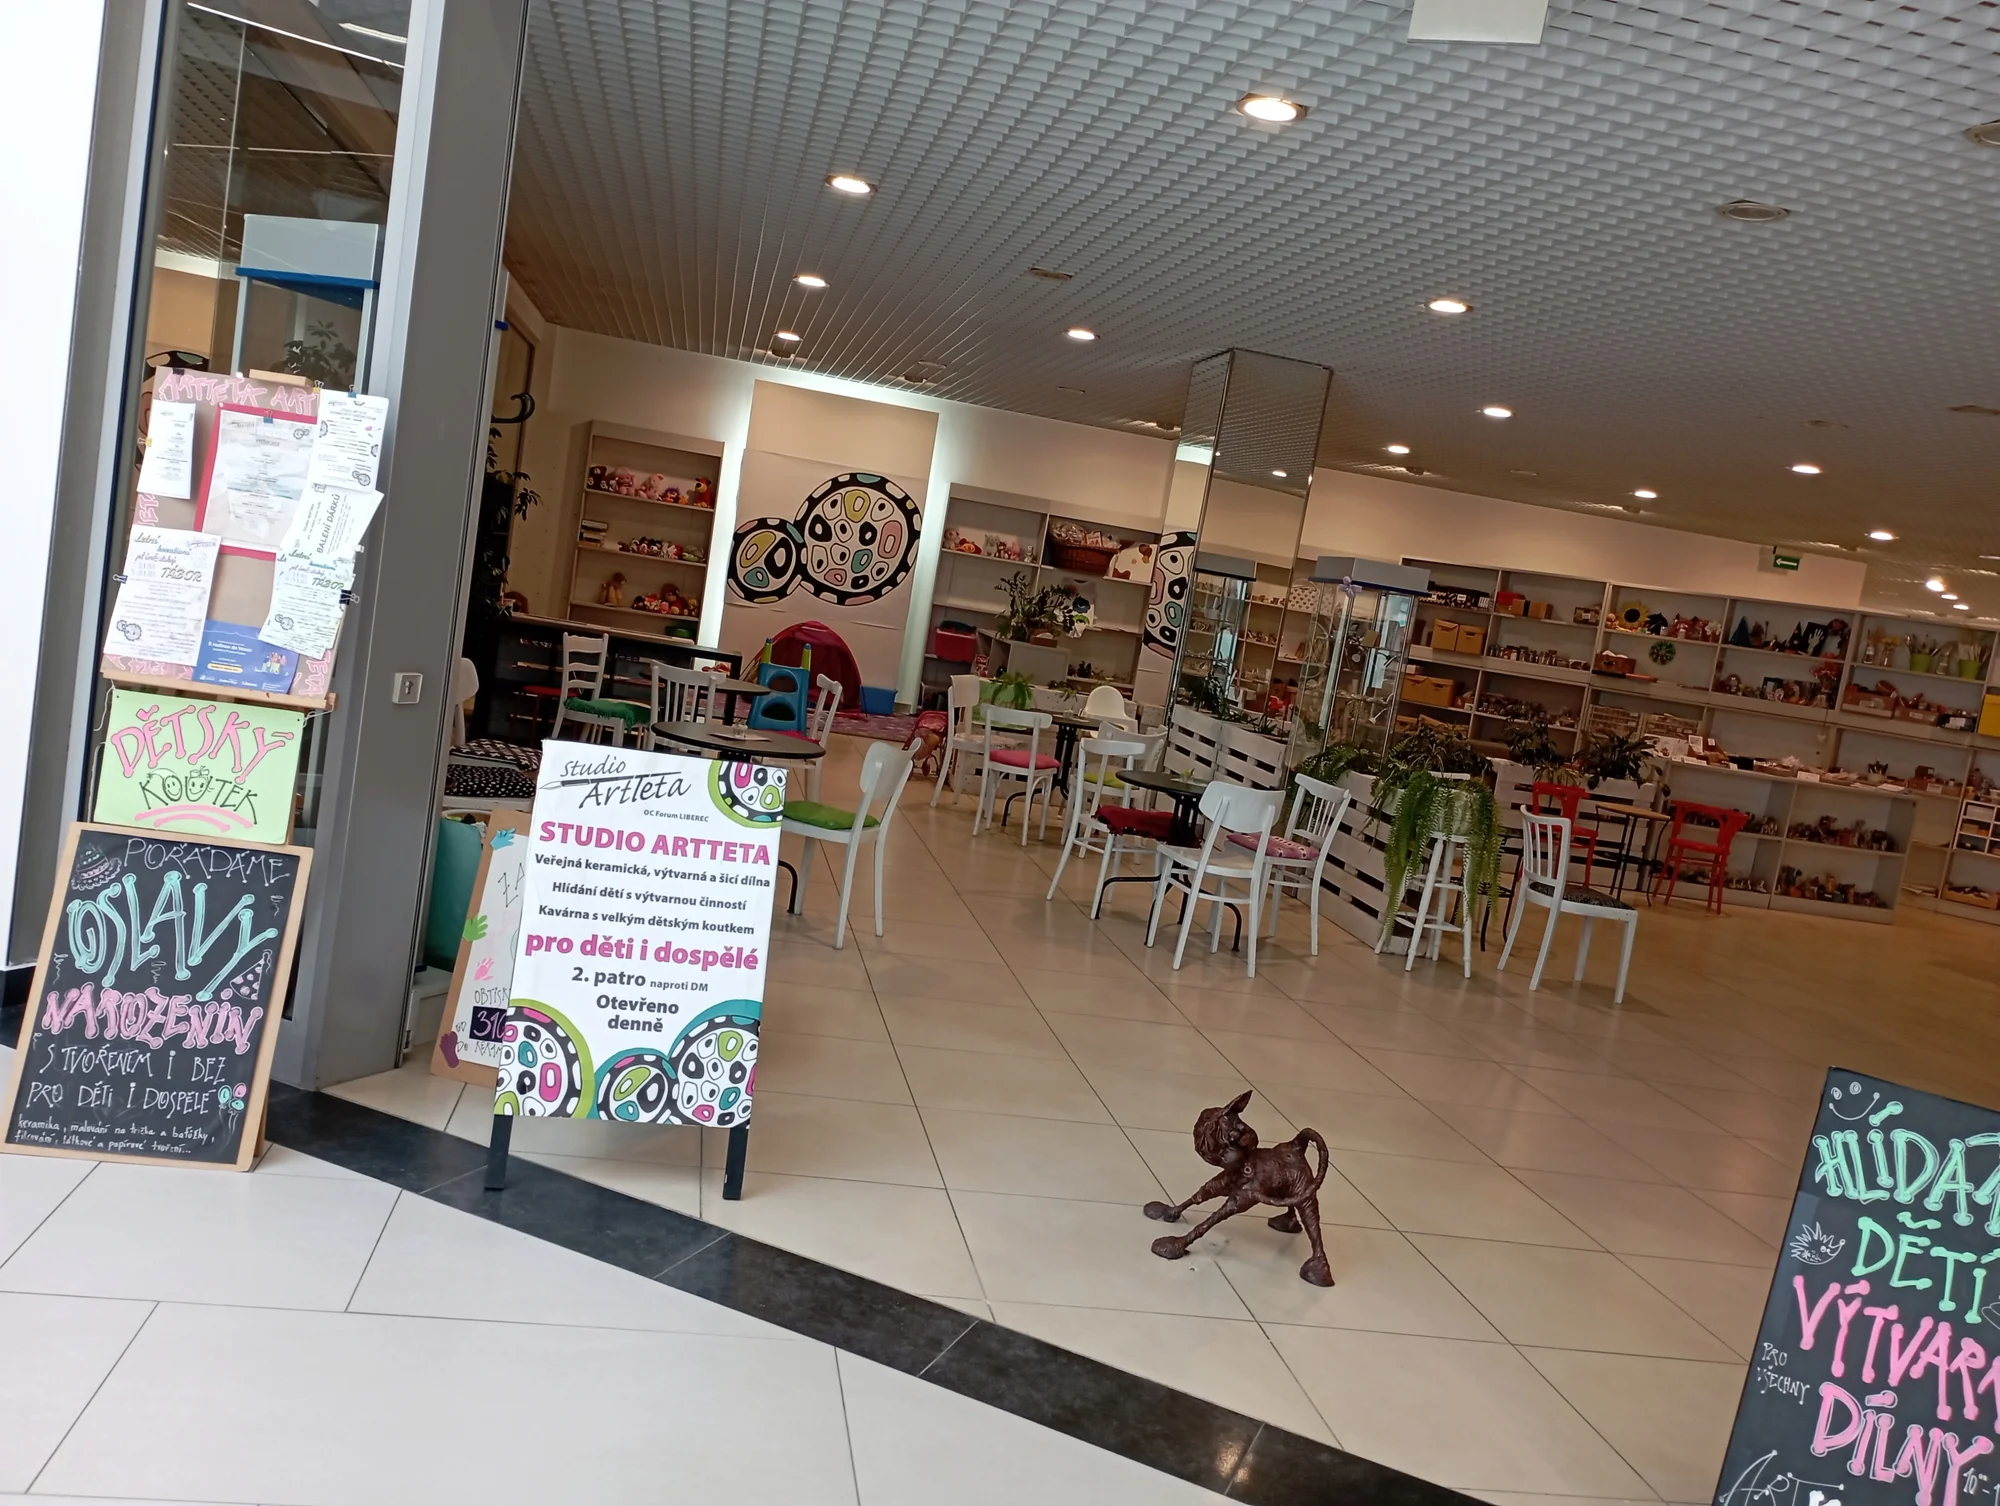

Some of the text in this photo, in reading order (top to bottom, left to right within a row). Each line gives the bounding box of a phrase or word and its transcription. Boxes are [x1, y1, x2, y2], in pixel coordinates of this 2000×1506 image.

[316, 522, 332, 554] BALENÍ
[326, 493, 341, 523] DÁRKŮ
[161, 565, 203, 583] TÁBOR
[110, 704, 295, 785] DĚTSKÝ
[138, 773, 258, 826] KOUTEK
[655, 810, 679, 820] Forum
[679, 813, 709, 823] LIBEREC
[124, 837, 291, 887] POŘÁDÁME
[539, 820, 771, 866] STUDIO ARTTETA
[534, 853, 771, 888] Veřejná keramická, výtvarná a šicí dílna
[552, 881, 748, 911] Hlídání dětí s výtvarnou činností
[66, 870, 279, 1001] OSLAVY
[538, 904, 755, 935] Kavárna s velkým dětským koutkem
[525, 933, 759, 971] pro děti i dospělé
[571, 966, 709, 992] 2. patro naproti DM
[41, 981, 264, 1055] NAROZENIN
[596, 994, 679, 1015] Otevřeno
[607, 1013, 664, 1033] denně
[61, 1043, 153, 1078] TVOŘENÍM
[191, 1056, 227, 1085] BEZ
[25, 1081, 64, 1108] PRO
[1761, 1341, 1788, 1367] PRO
[1757, 1365, 1810, 1406] VŠECHNY
[1811, 1381, 1994, 1506] DÍLNY
